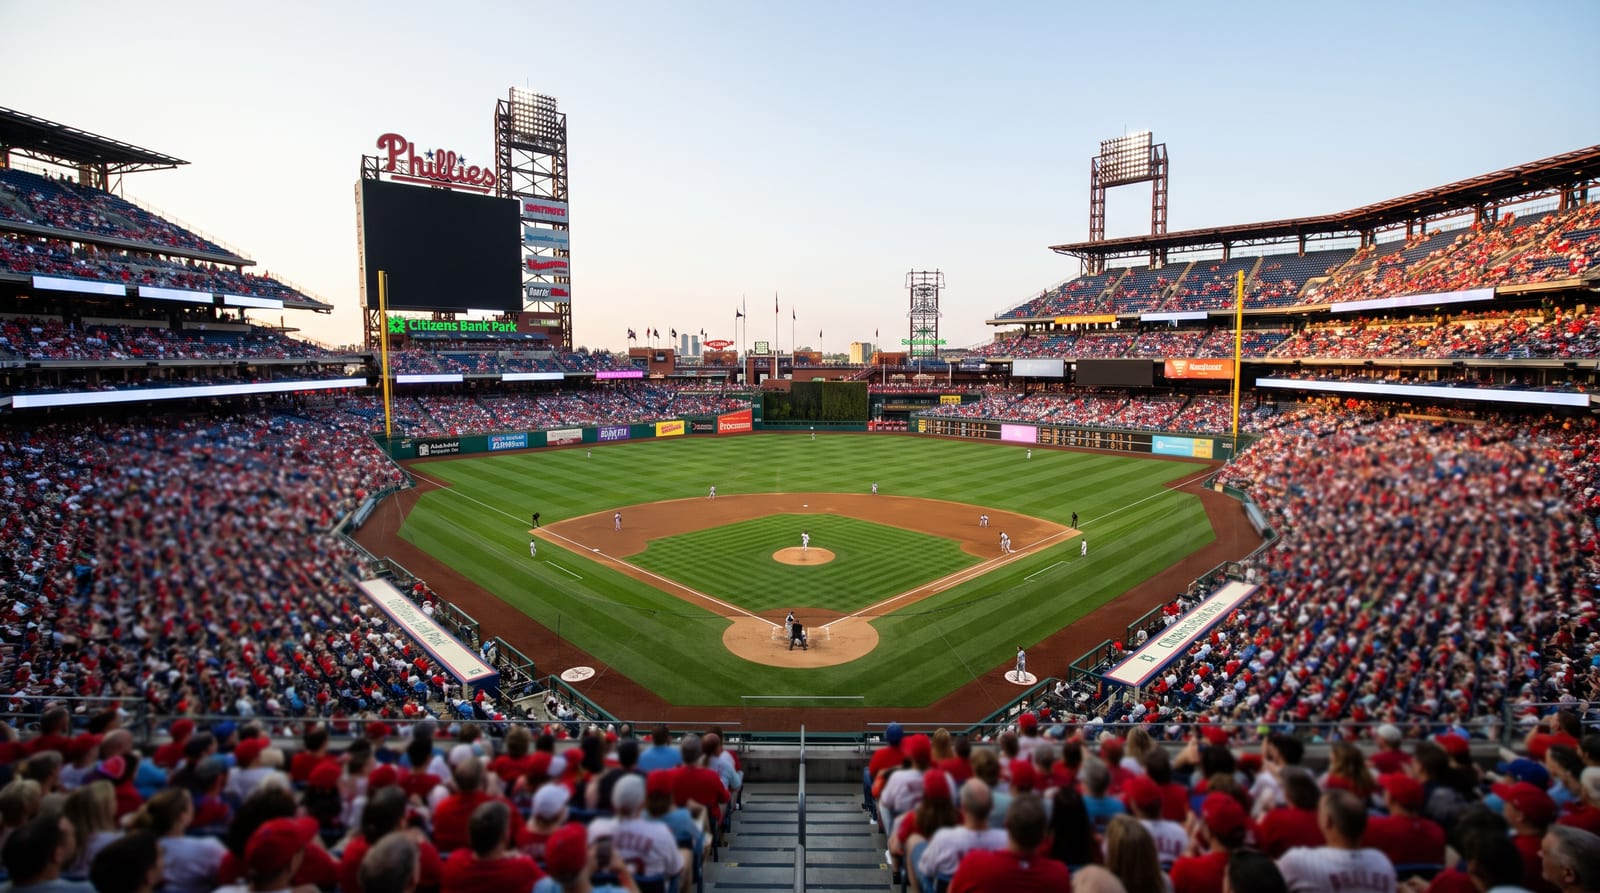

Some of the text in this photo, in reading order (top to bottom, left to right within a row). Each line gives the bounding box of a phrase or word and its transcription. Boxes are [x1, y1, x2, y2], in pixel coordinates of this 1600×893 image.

[376, 133, 496, 187] Phillies
[408, 320, 517, 332] Citizens Bank Park
